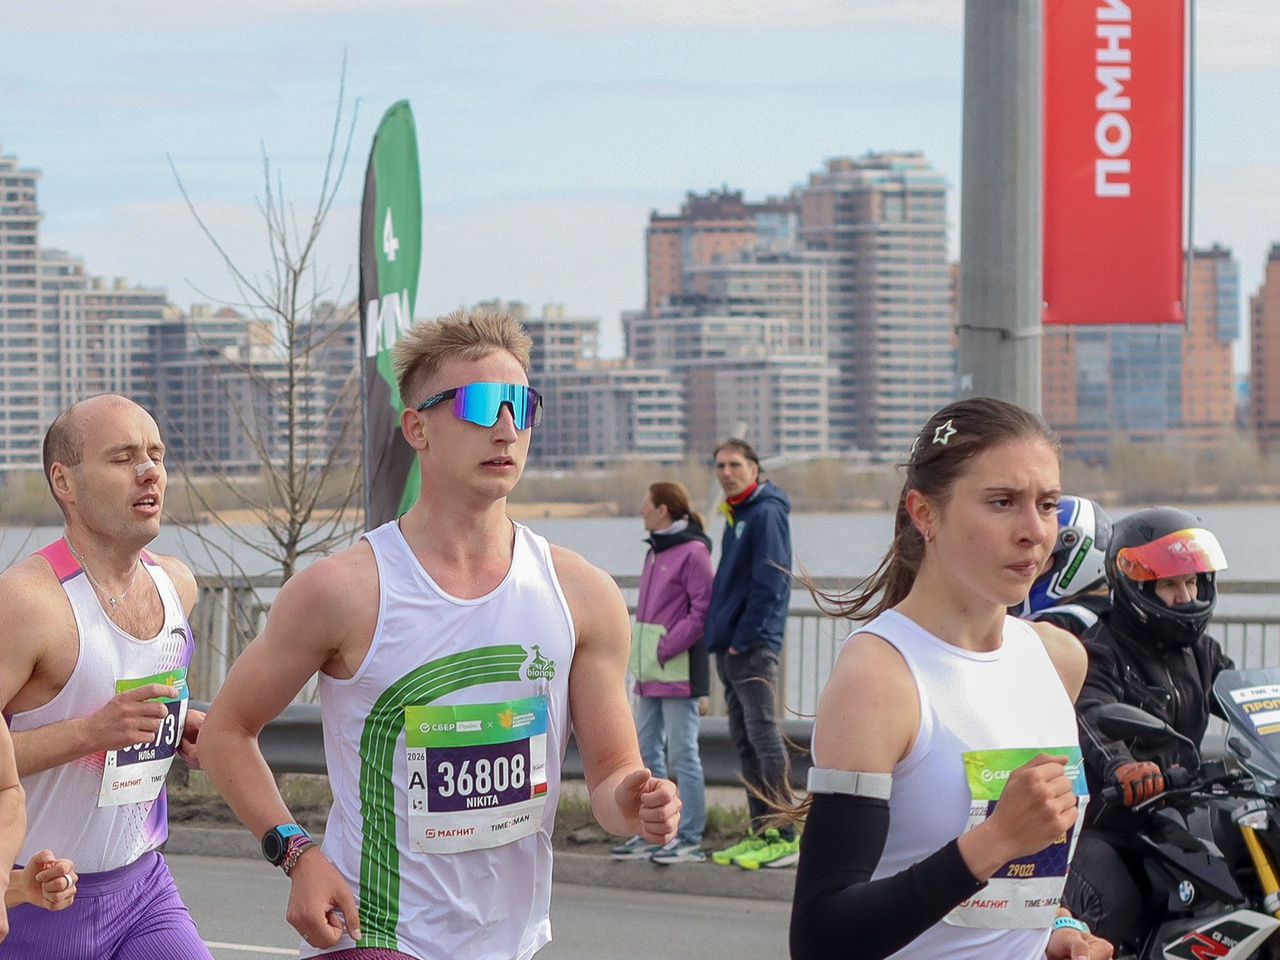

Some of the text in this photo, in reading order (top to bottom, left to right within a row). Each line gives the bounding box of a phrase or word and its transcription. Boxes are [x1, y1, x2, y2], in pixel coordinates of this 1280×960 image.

[383, 206, 400, 262] 4
[432, 723, 455, 731] СБЕР
[138, 750, 156, 761] ИЛЬЯ
[407, 752, 425, 761] 2026
[408, 771, 426, 790] A
[437, 753, 525, 798] 36808
[993, 770, 1012, 780] СБЕ
[120, 779, 142, 789] МАГНИТ
[466, 794, 499, 809] NIKITA
[437, 827, 475, 838] МАГНИТ
[1007, 863, 1036, 877] 29022
[971, 899, 1010, 909] МАГНИТ
